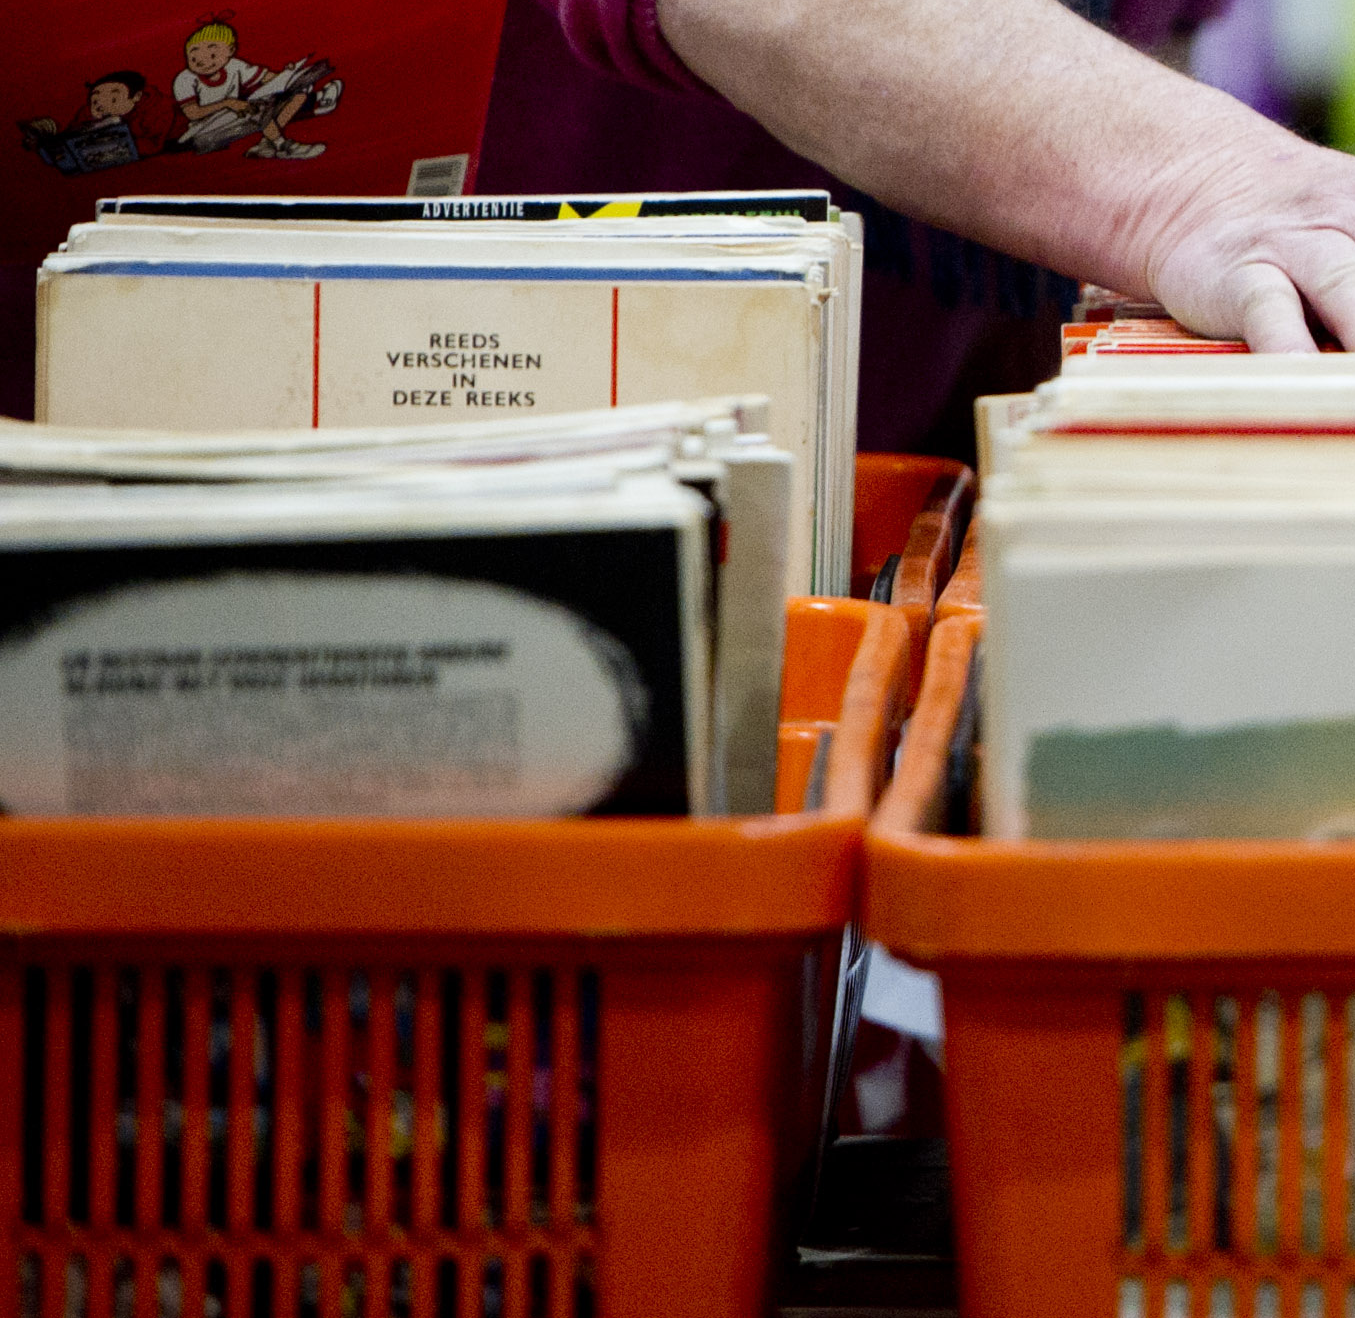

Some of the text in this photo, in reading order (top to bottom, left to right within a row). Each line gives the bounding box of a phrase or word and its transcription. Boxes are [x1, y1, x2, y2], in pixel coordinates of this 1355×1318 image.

[422, 201, 525, 218] ADVERTENTIE
[429, 333, 500, 349] REEDS
[386, 352, 542, 369] VERSCHENEN
[452, 373, 476, 388] IN
[392, 390, 536, 407] DEZE REEKS
